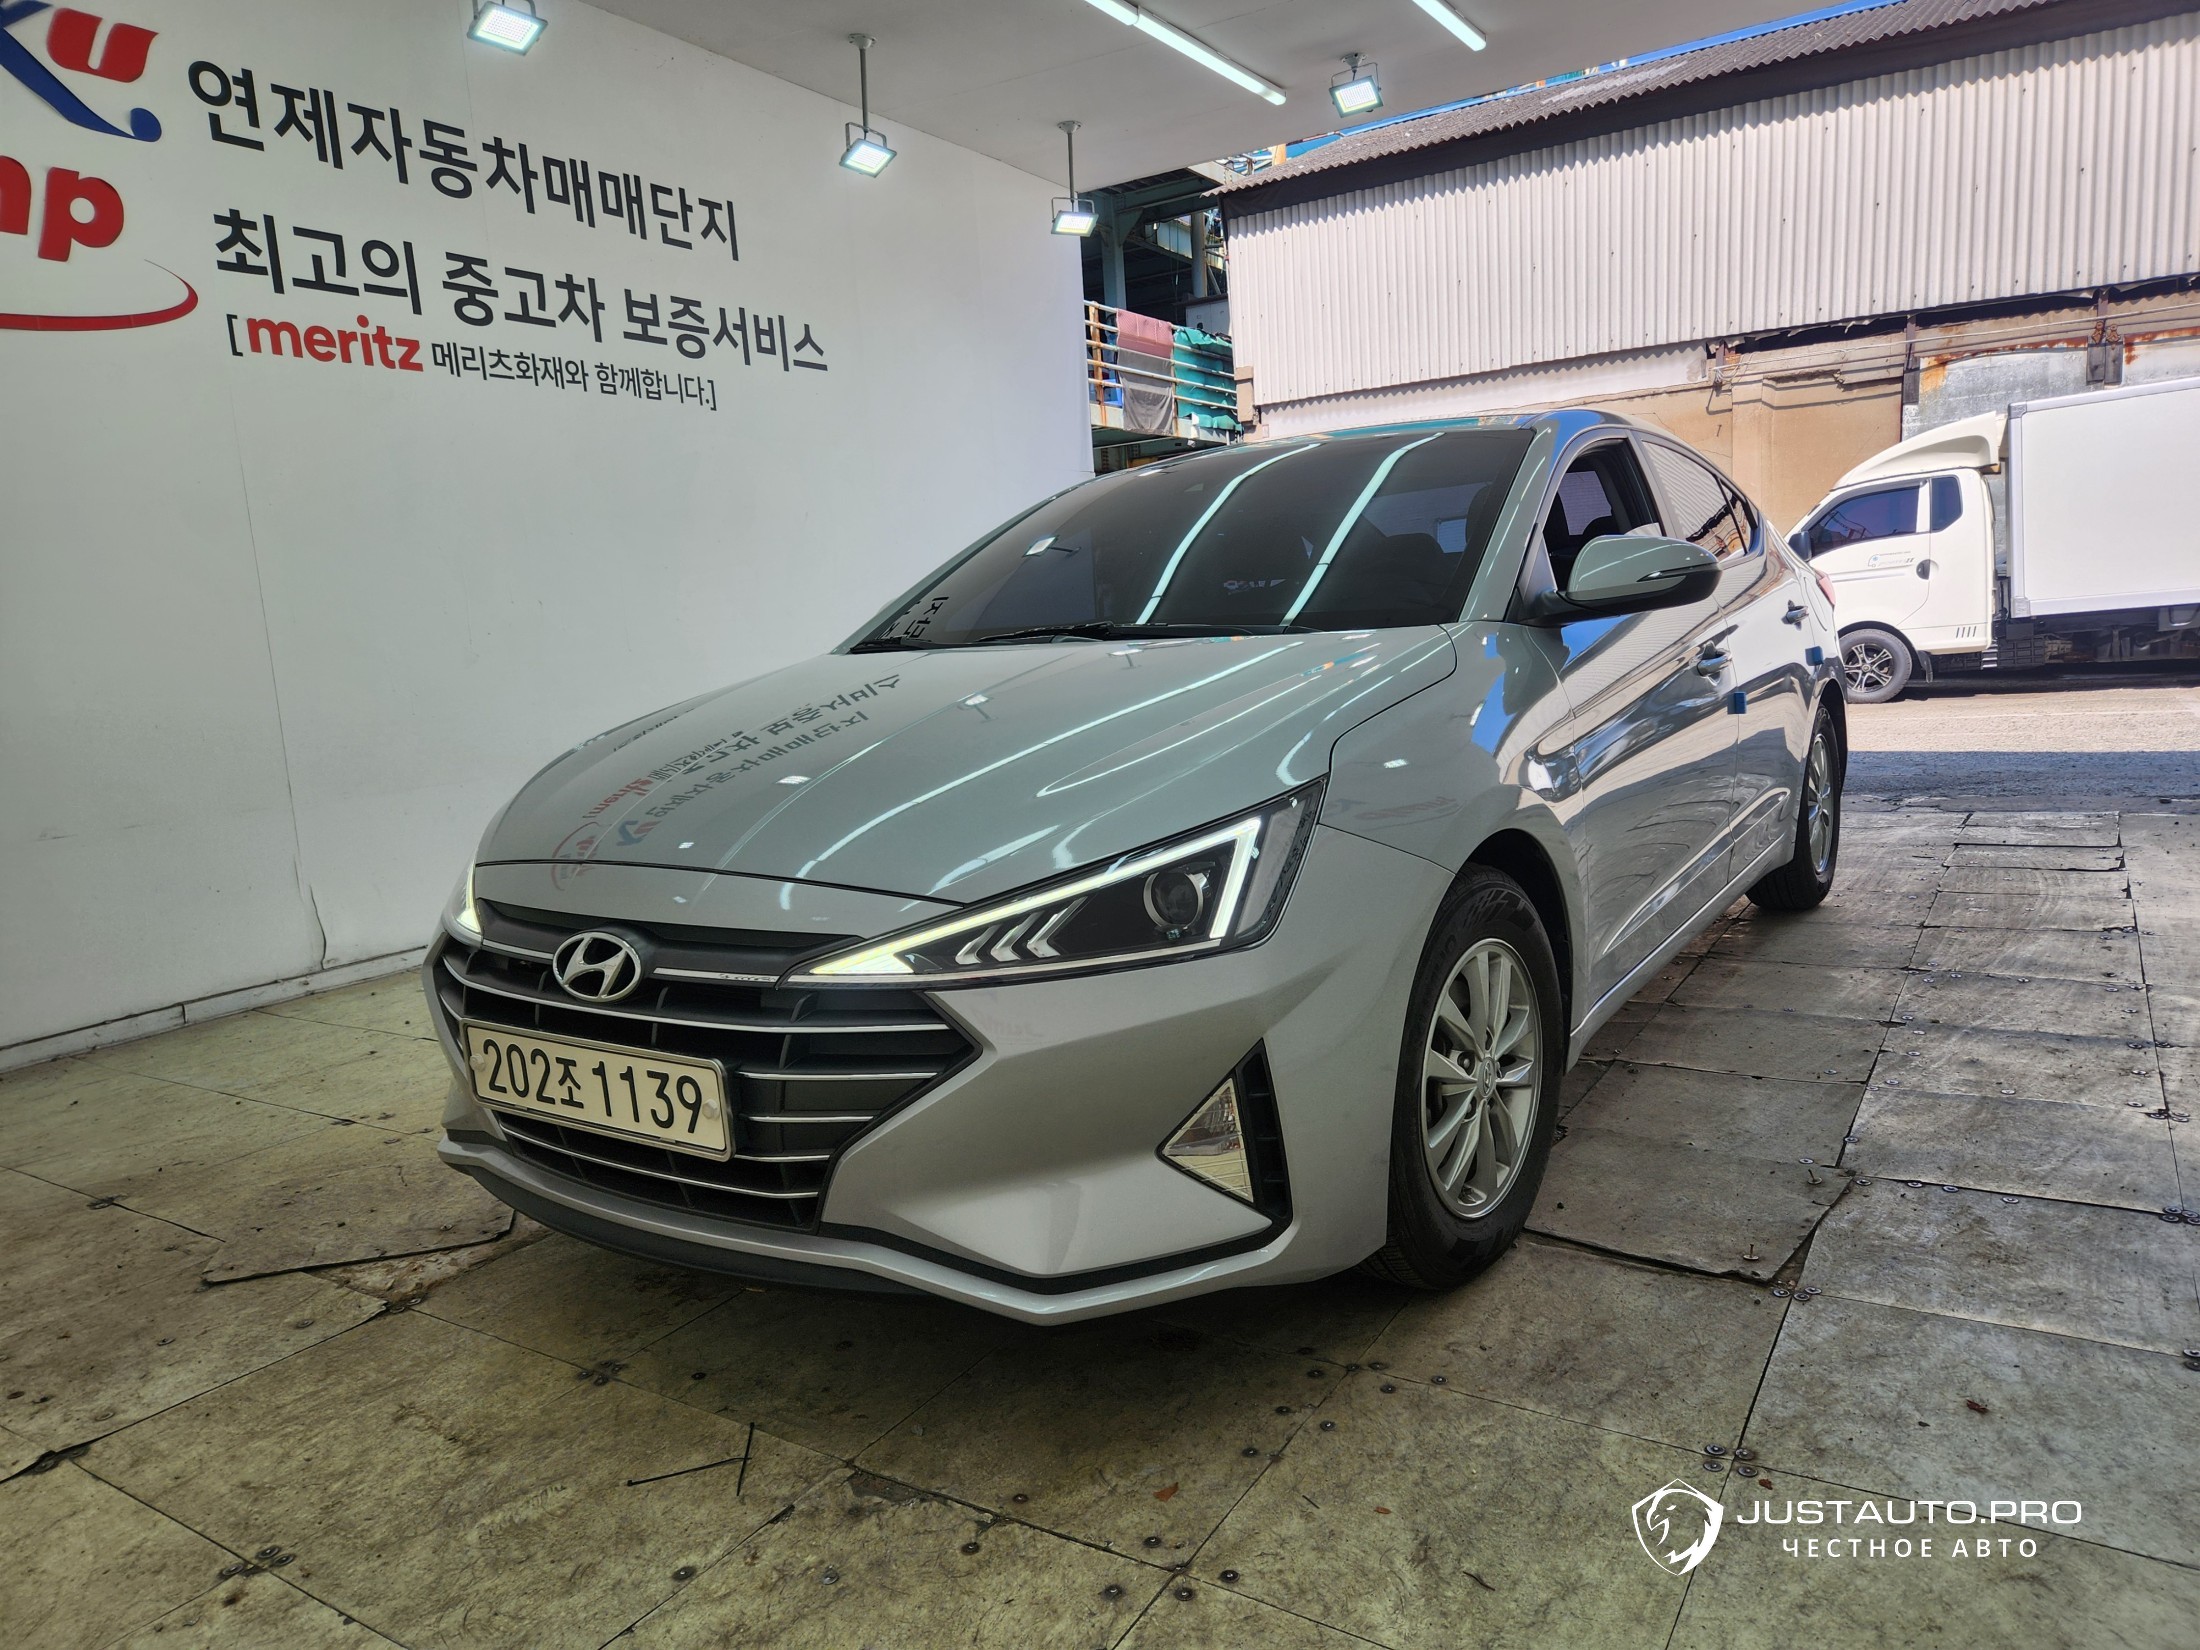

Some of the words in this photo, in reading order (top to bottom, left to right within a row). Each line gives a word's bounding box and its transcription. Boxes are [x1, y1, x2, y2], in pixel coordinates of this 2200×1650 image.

[188, 61, 739, 262] 연제자동차매매단지
[213, 208, 422, 315] 최고의
[442, 251, 605, 343] 중고차
[623, 288, 828, 372] 보증서비스
[431, 342, 589, 392] 메리츠화재와
[594, 362, 717, 411] 함께합니다.]
